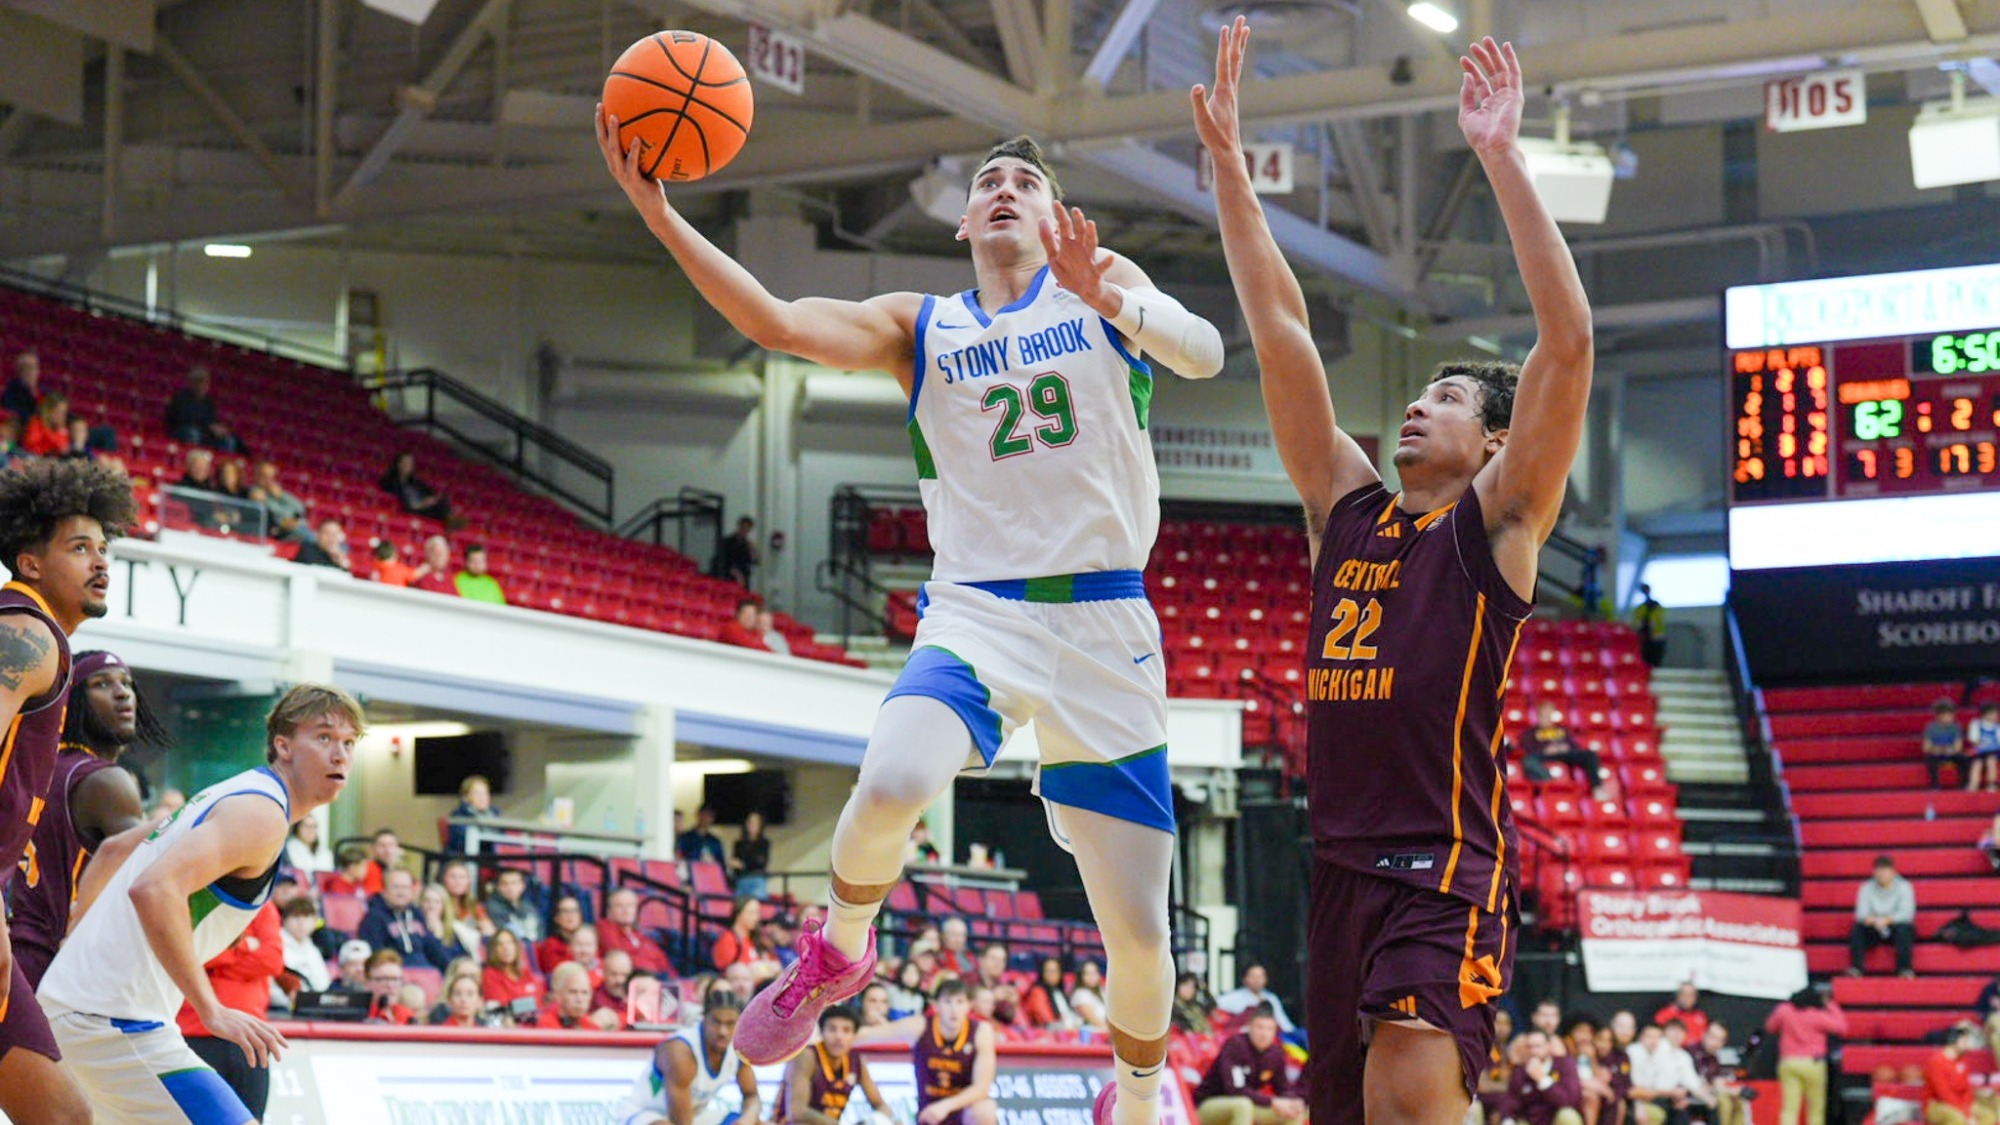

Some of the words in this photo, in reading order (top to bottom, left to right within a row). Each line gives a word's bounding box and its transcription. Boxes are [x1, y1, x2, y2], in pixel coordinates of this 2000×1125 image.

[1791, 78, 1852, 119] 105
[937, 336, 1009, 384] STONY
[1018, 317, 1092, 366] BROOK
[981, 370, 1079, 462] 29
[1855, 399, 1902, 440] 62
[1951, 398, 1973, 430] 2
[1333, 558, 1400, 592] CENTRAL
[1321, 597, 1383, 661] 22
